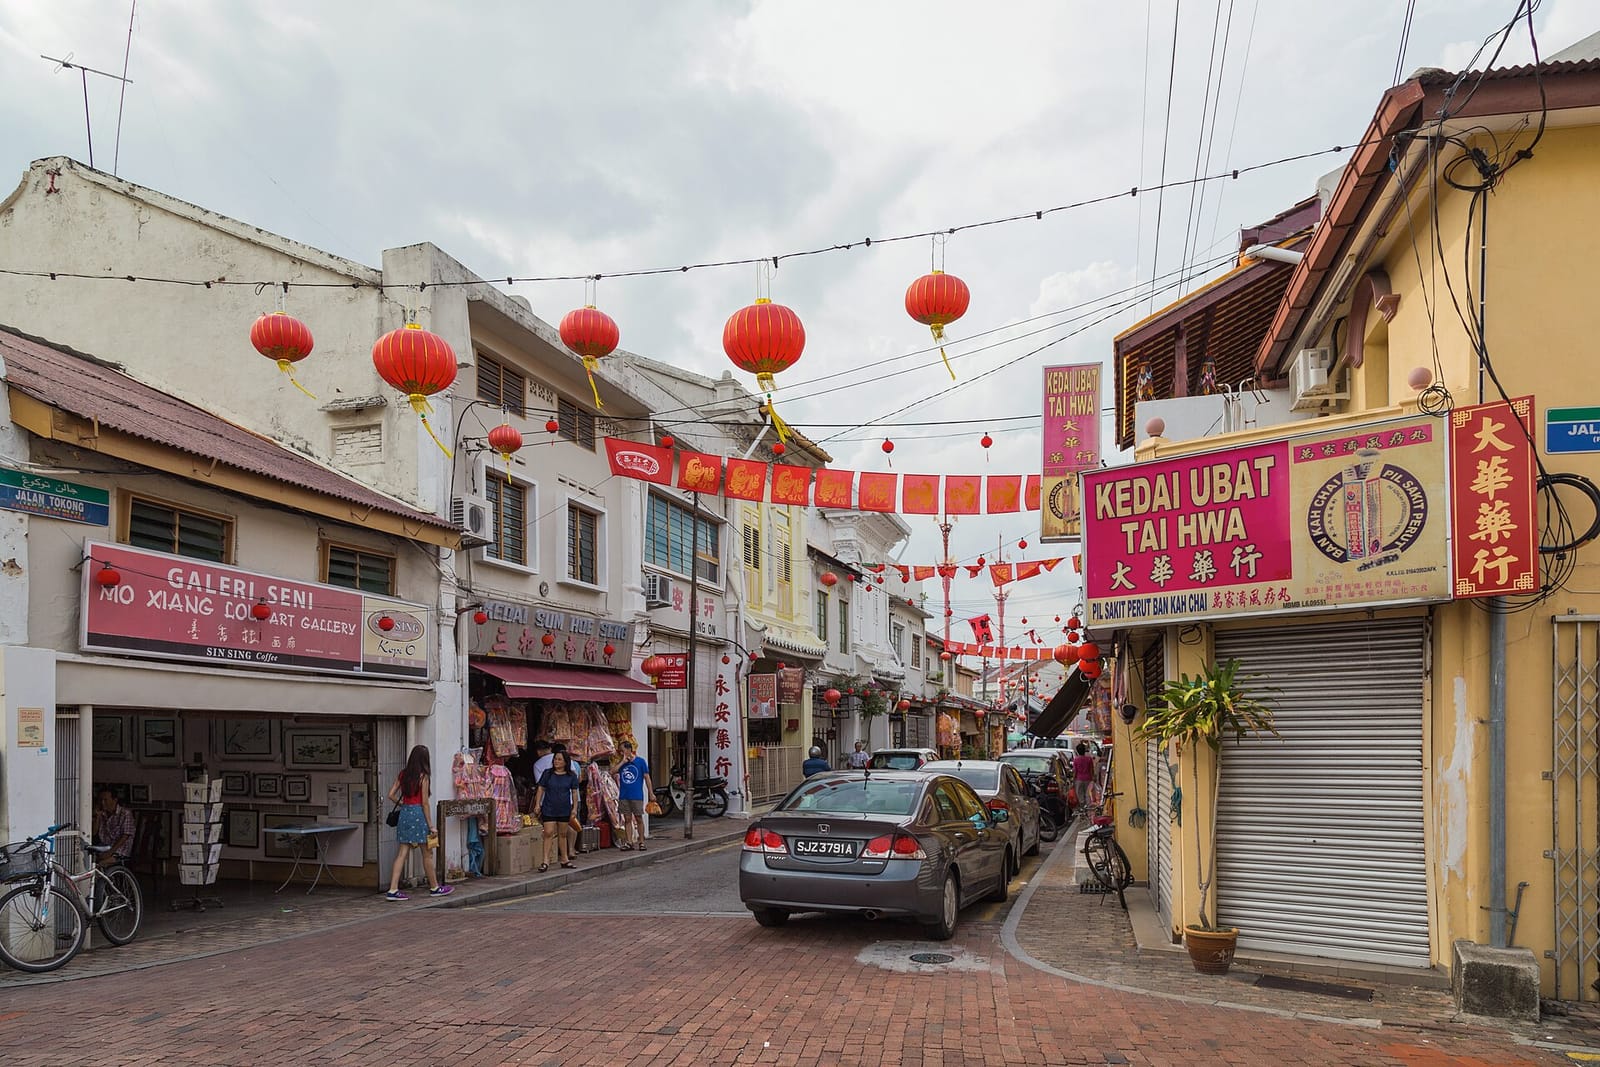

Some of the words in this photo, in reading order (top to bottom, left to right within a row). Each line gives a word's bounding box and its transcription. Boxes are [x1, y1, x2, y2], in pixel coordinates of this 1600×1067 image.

[1048, 372, 1072, 394] KEDAI
[1074, 369, 1098, 392] UBAT
[1049, 396, 1066, 416] TAI
[1070, 394, 1094, 416] HWA
[1568, 424, 1600, 435] JAL
[1095, 472, 1180, 520] KEDAI
[1189, 455, 1275, 507] UBAT
[1382, 470, 1404, 483] PIL
[16, 490, 44, 504] JALAN
[50, 496, 84, 512] TOKONG
[1314, 478, 1342, 506] CHAI
[1402, 480, 1424, 510] SAKIT
[1468, 416, 1519, 584] 大華藥行
[1121, 518, 1168, 554] TAI
[1177, 508, 1247, 548] HWA
[1310, 510, 1324, 536] KAH
[1394, 512, 1424, 548] PERUT
[1317, 536, 1344, 558] BAN
[1110, 544, 1263, 591] 大華藥行
[168, 568, 254, 600] GALERI
[268, 586, 313, 610] SENI
[100, 585, 134, 605] MO
[146, 590, 214, 616] XIANG
[269, 612, 295, 628] ART
[300, 616, 357, 636] GALLERY
[1092, 603, 1103, 620] PIL
[1105, 601, 1126, 620] SAKIT
[1128, 598, 1151, 617] PERUT
[1153, 597, 1168, 615] BAN
[1171, 595, 1186, 614] KAH
[1188, 592, 1207, 612] CHAI
[396, 621, 418, 634] SING
[484, 601, 528, 624] KEDAI
[570, 616, 594, 634] HOE
[599, 622, 626, 640] SENG
[207, 648, 224, 656] SIN
[228, 650, 251, 660] SING
[256, 652, 278, 662] Coffee
